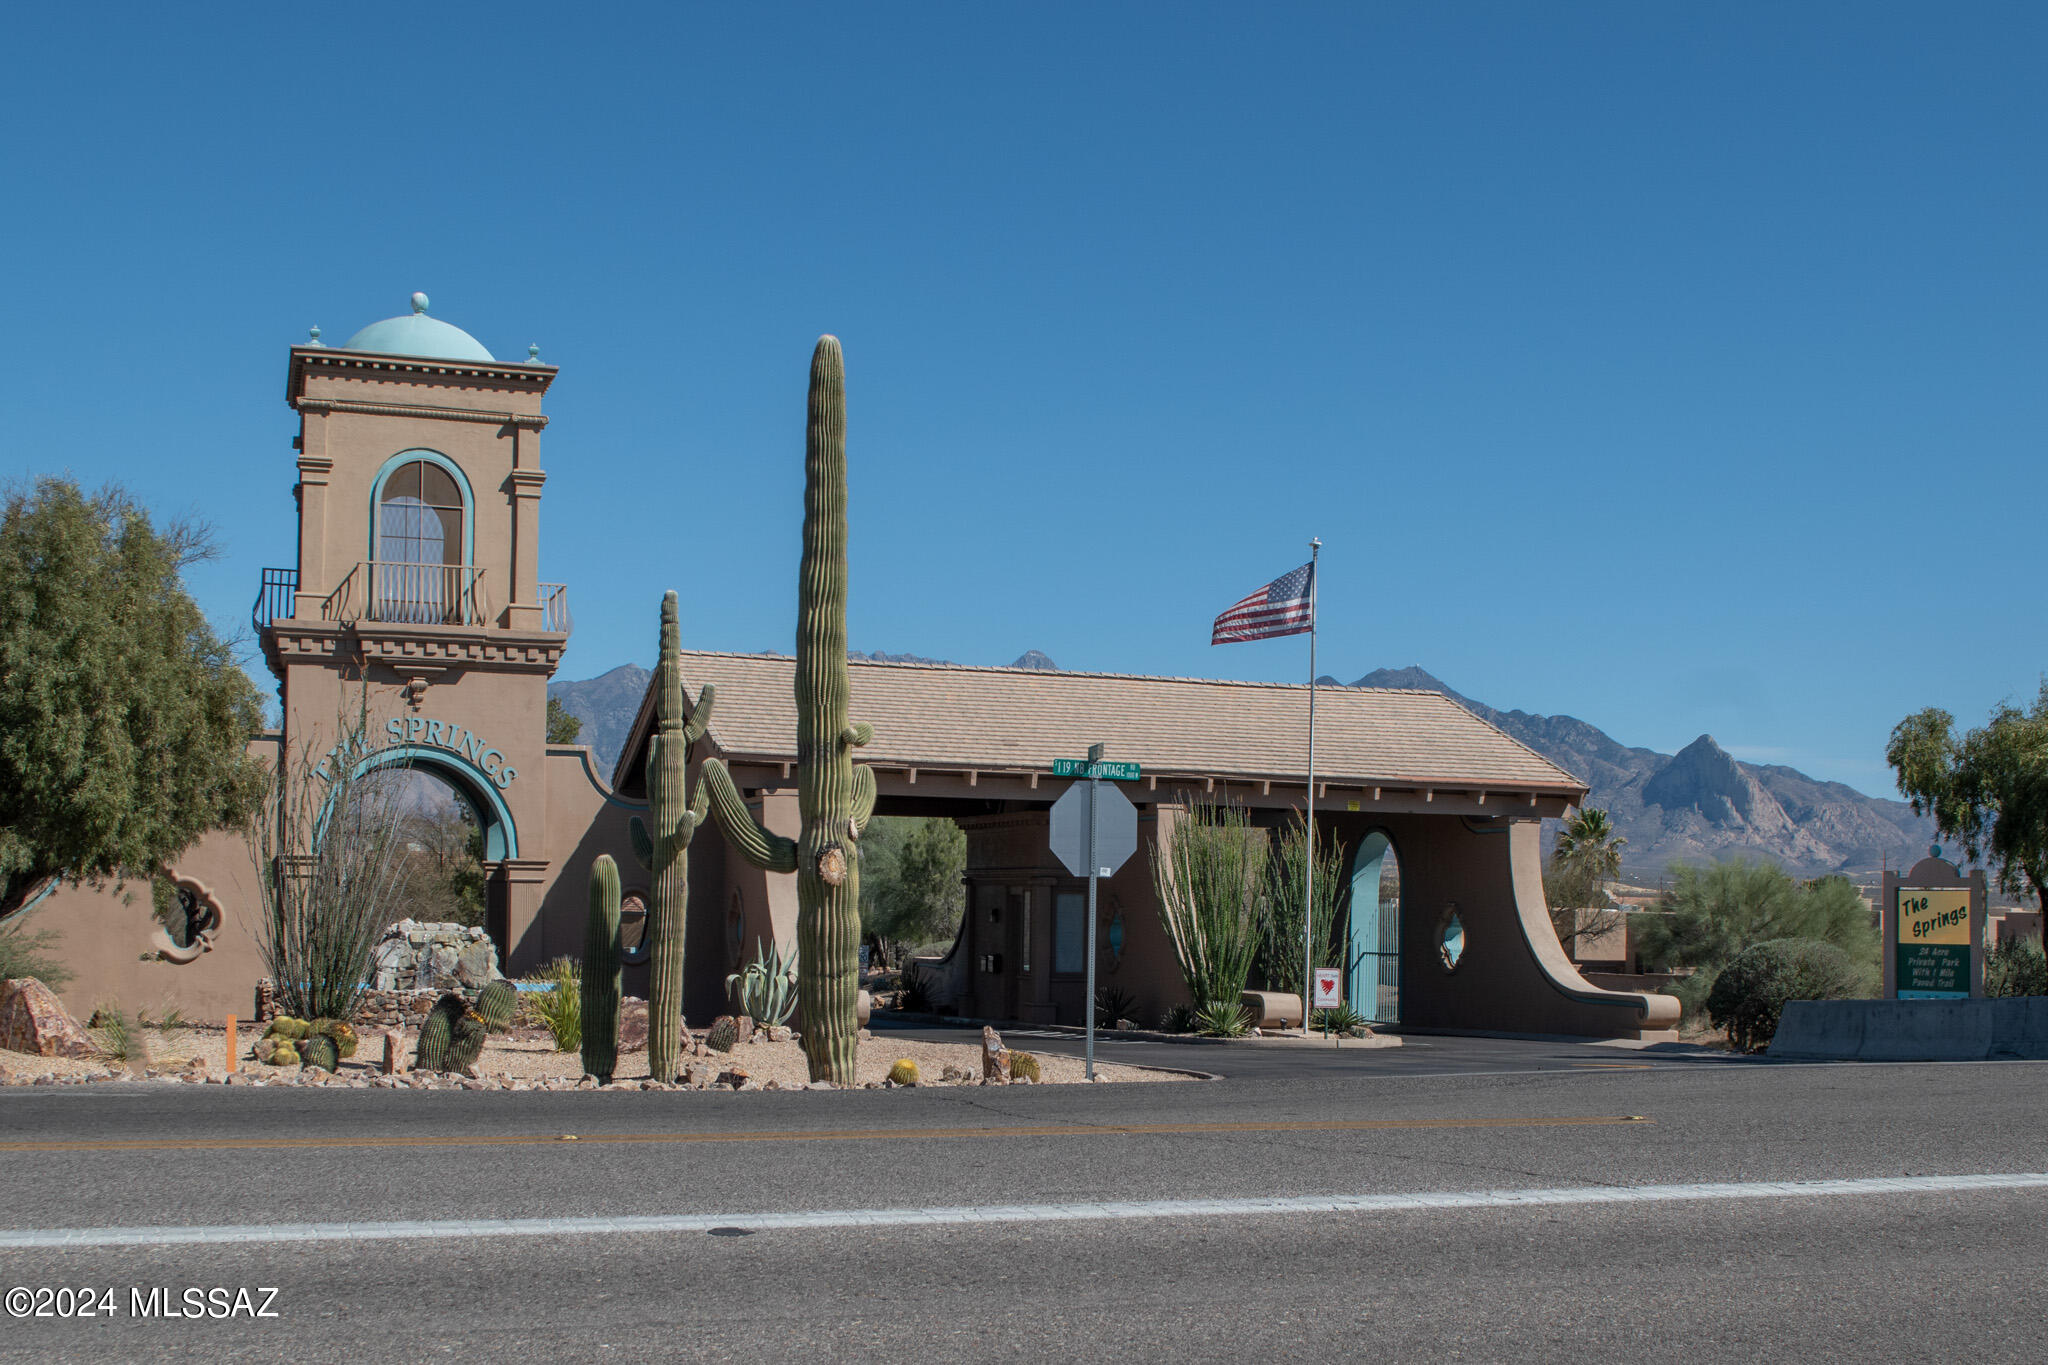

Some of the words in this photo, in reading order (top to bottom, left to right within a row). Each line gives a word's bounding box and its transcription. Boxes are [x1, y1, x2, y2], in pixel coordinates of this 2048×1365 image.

[386, 717, 518, 789] SPRINGS
[1063, 761, 1071, 773] 19
[1074, 763, 1085, 775] NB
[1088, 763, 1126, 777] FRONTAGE
[1902, 897, 1929, 917] The
[1912, 906, 1968, 938] Springs
[1908, 957, 1936, 967] Private
[1941, 958, 1960, 967] Park
[1912, 967, 1930, 977] With
[1939, 968, 1954, 977] Mile
[1911, 978, 1935, 987] Paved
[1937, 978, 1955, 987] Trail
